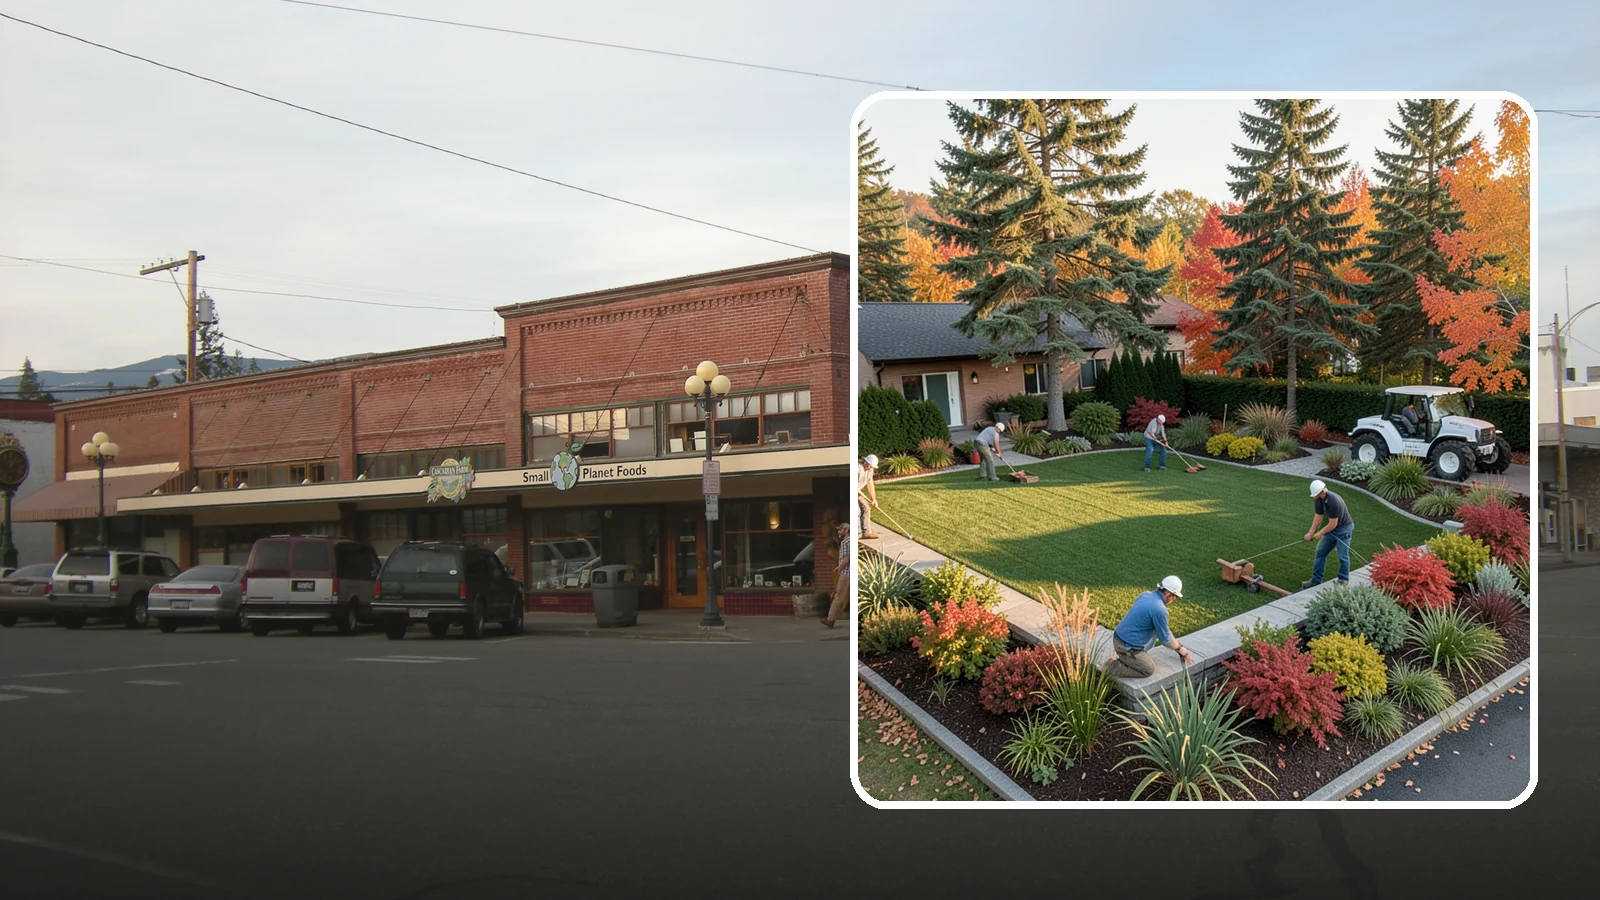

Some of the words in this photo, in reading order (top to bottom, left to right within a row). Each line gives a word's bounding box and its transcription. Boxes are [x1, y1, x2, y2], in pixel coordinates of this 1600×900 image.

[522, 470, 549, 483] Small
[582, 467, 614, 479] Planet
[617, 464, 647, 477] Foods
